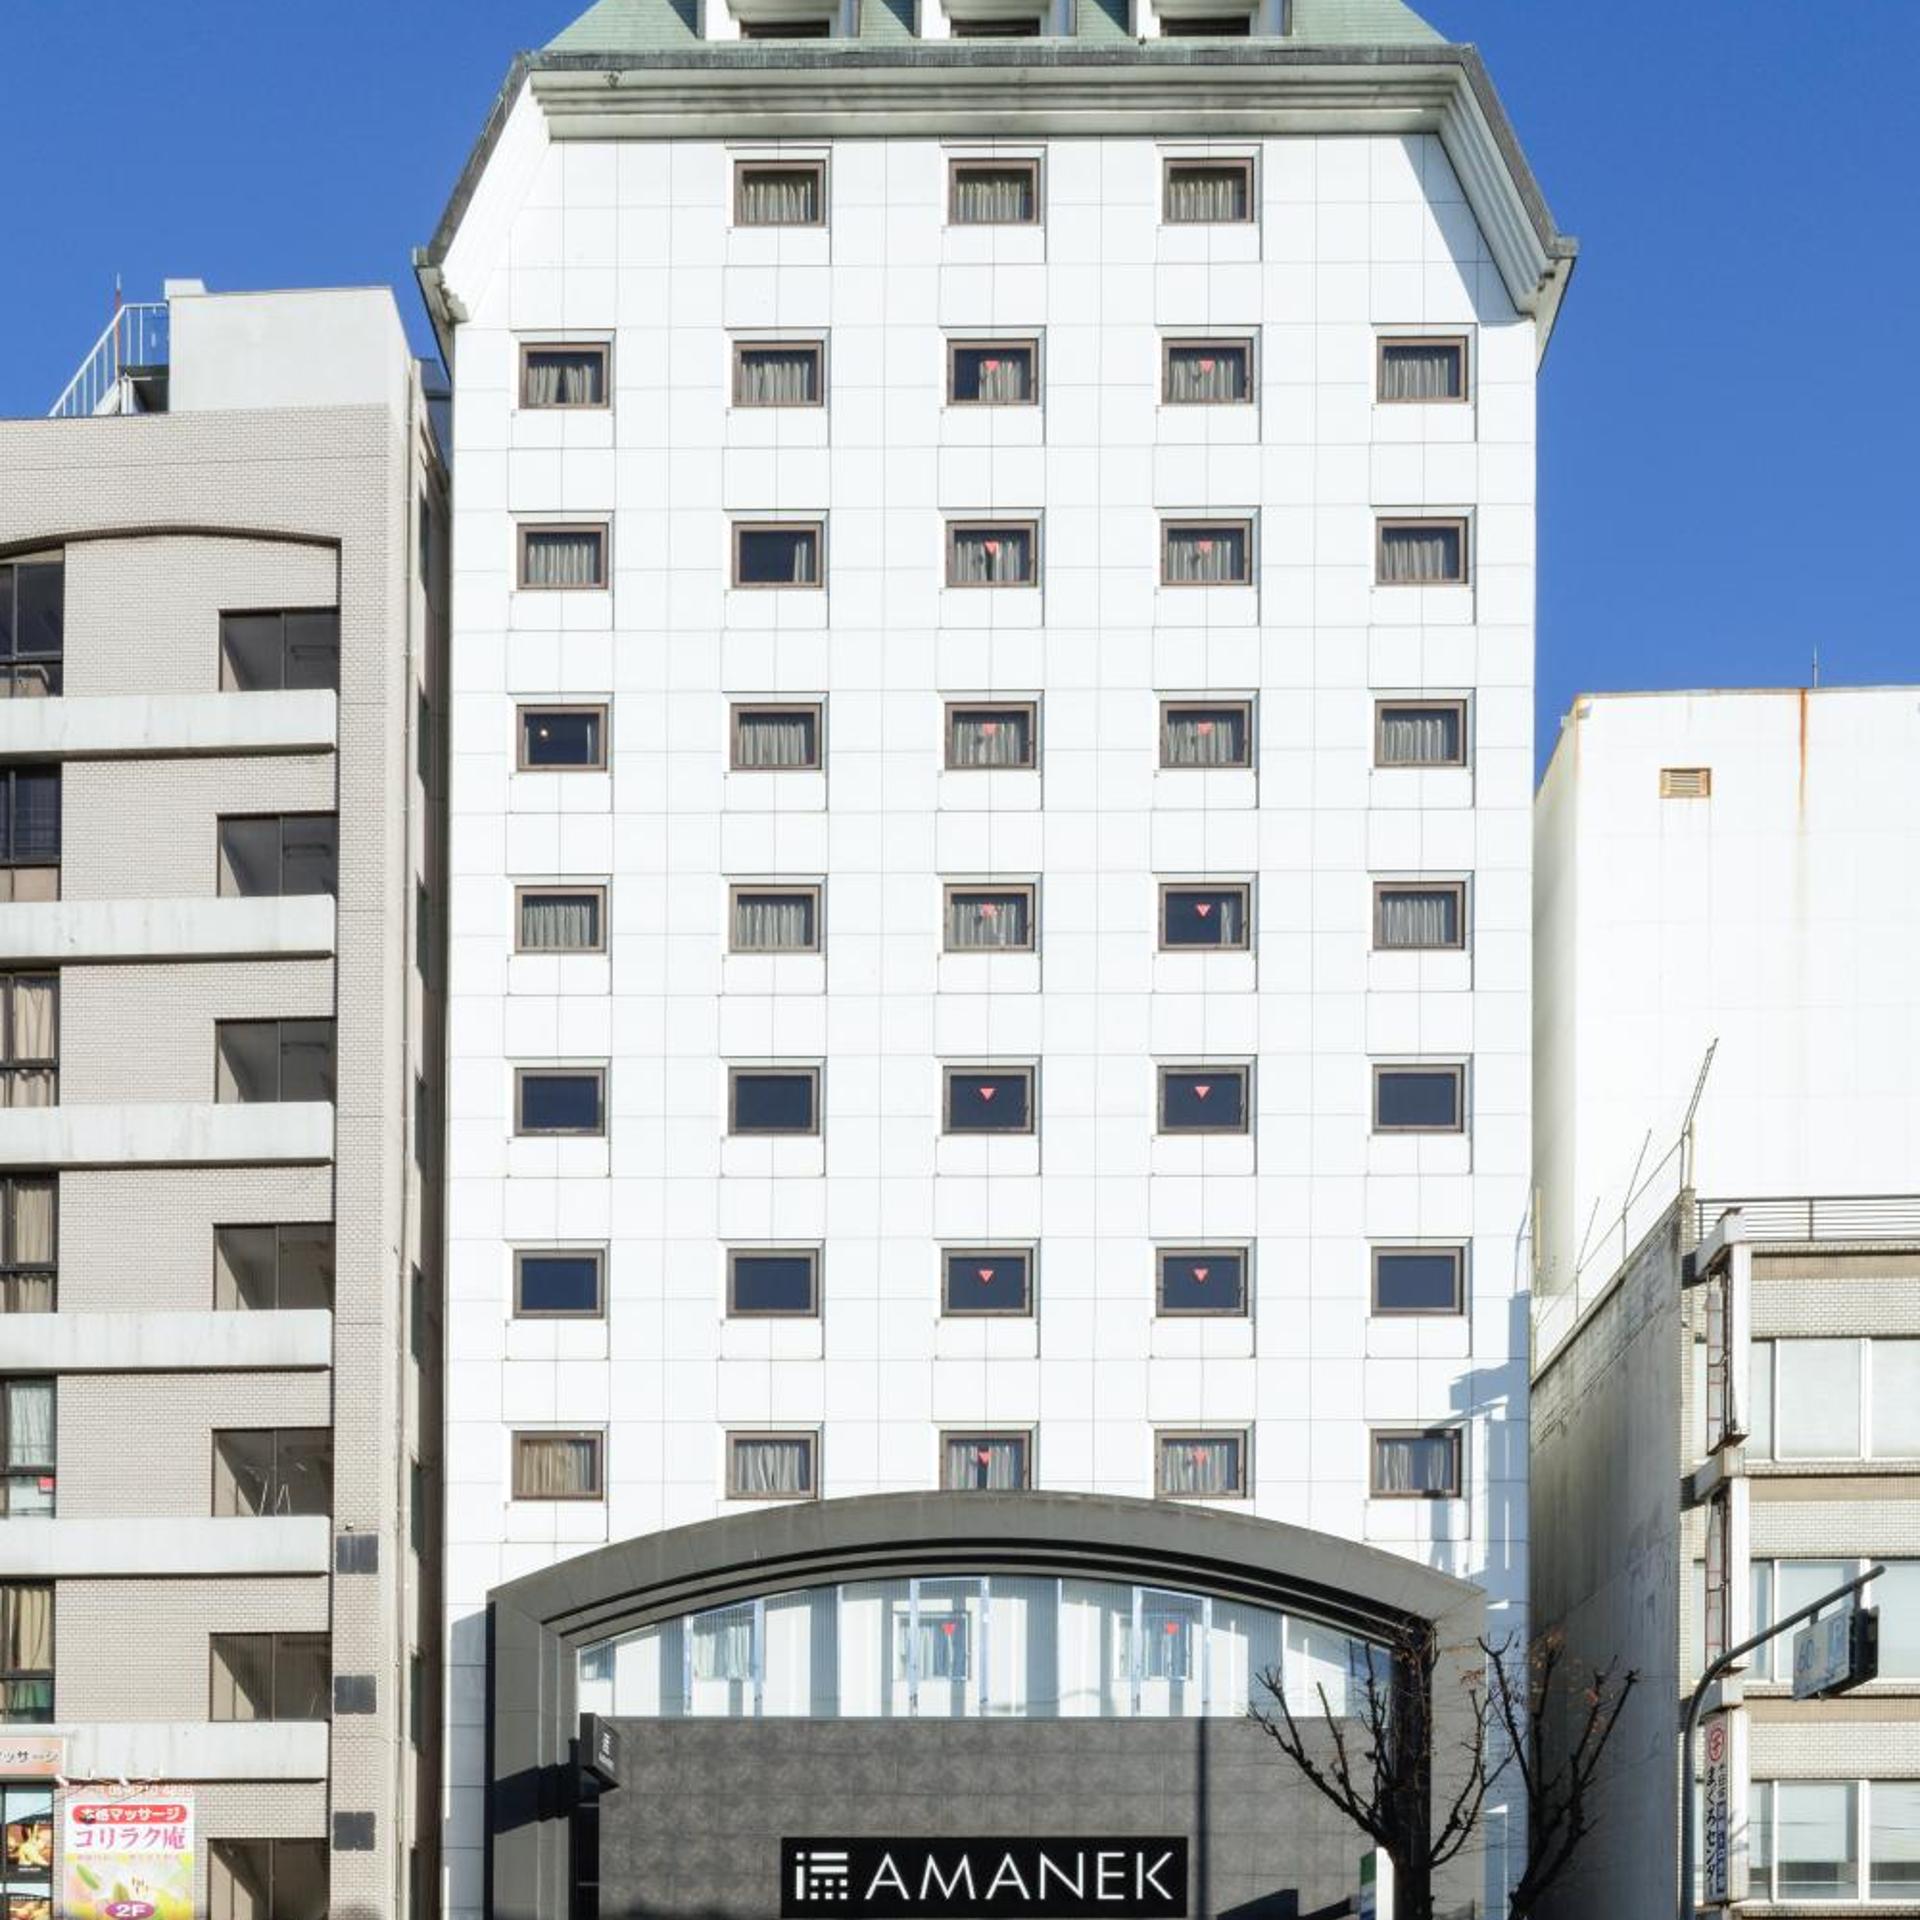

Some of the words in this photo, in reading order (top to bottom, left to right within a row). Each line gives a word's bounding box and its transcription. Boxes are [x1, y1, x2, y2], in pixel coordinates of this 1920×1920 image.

[0, 1750, 59, 1764] ッサージ
[864, 1852, 1173, 1900] AMANEK
[116, 1904, 146, 1917] 2F
